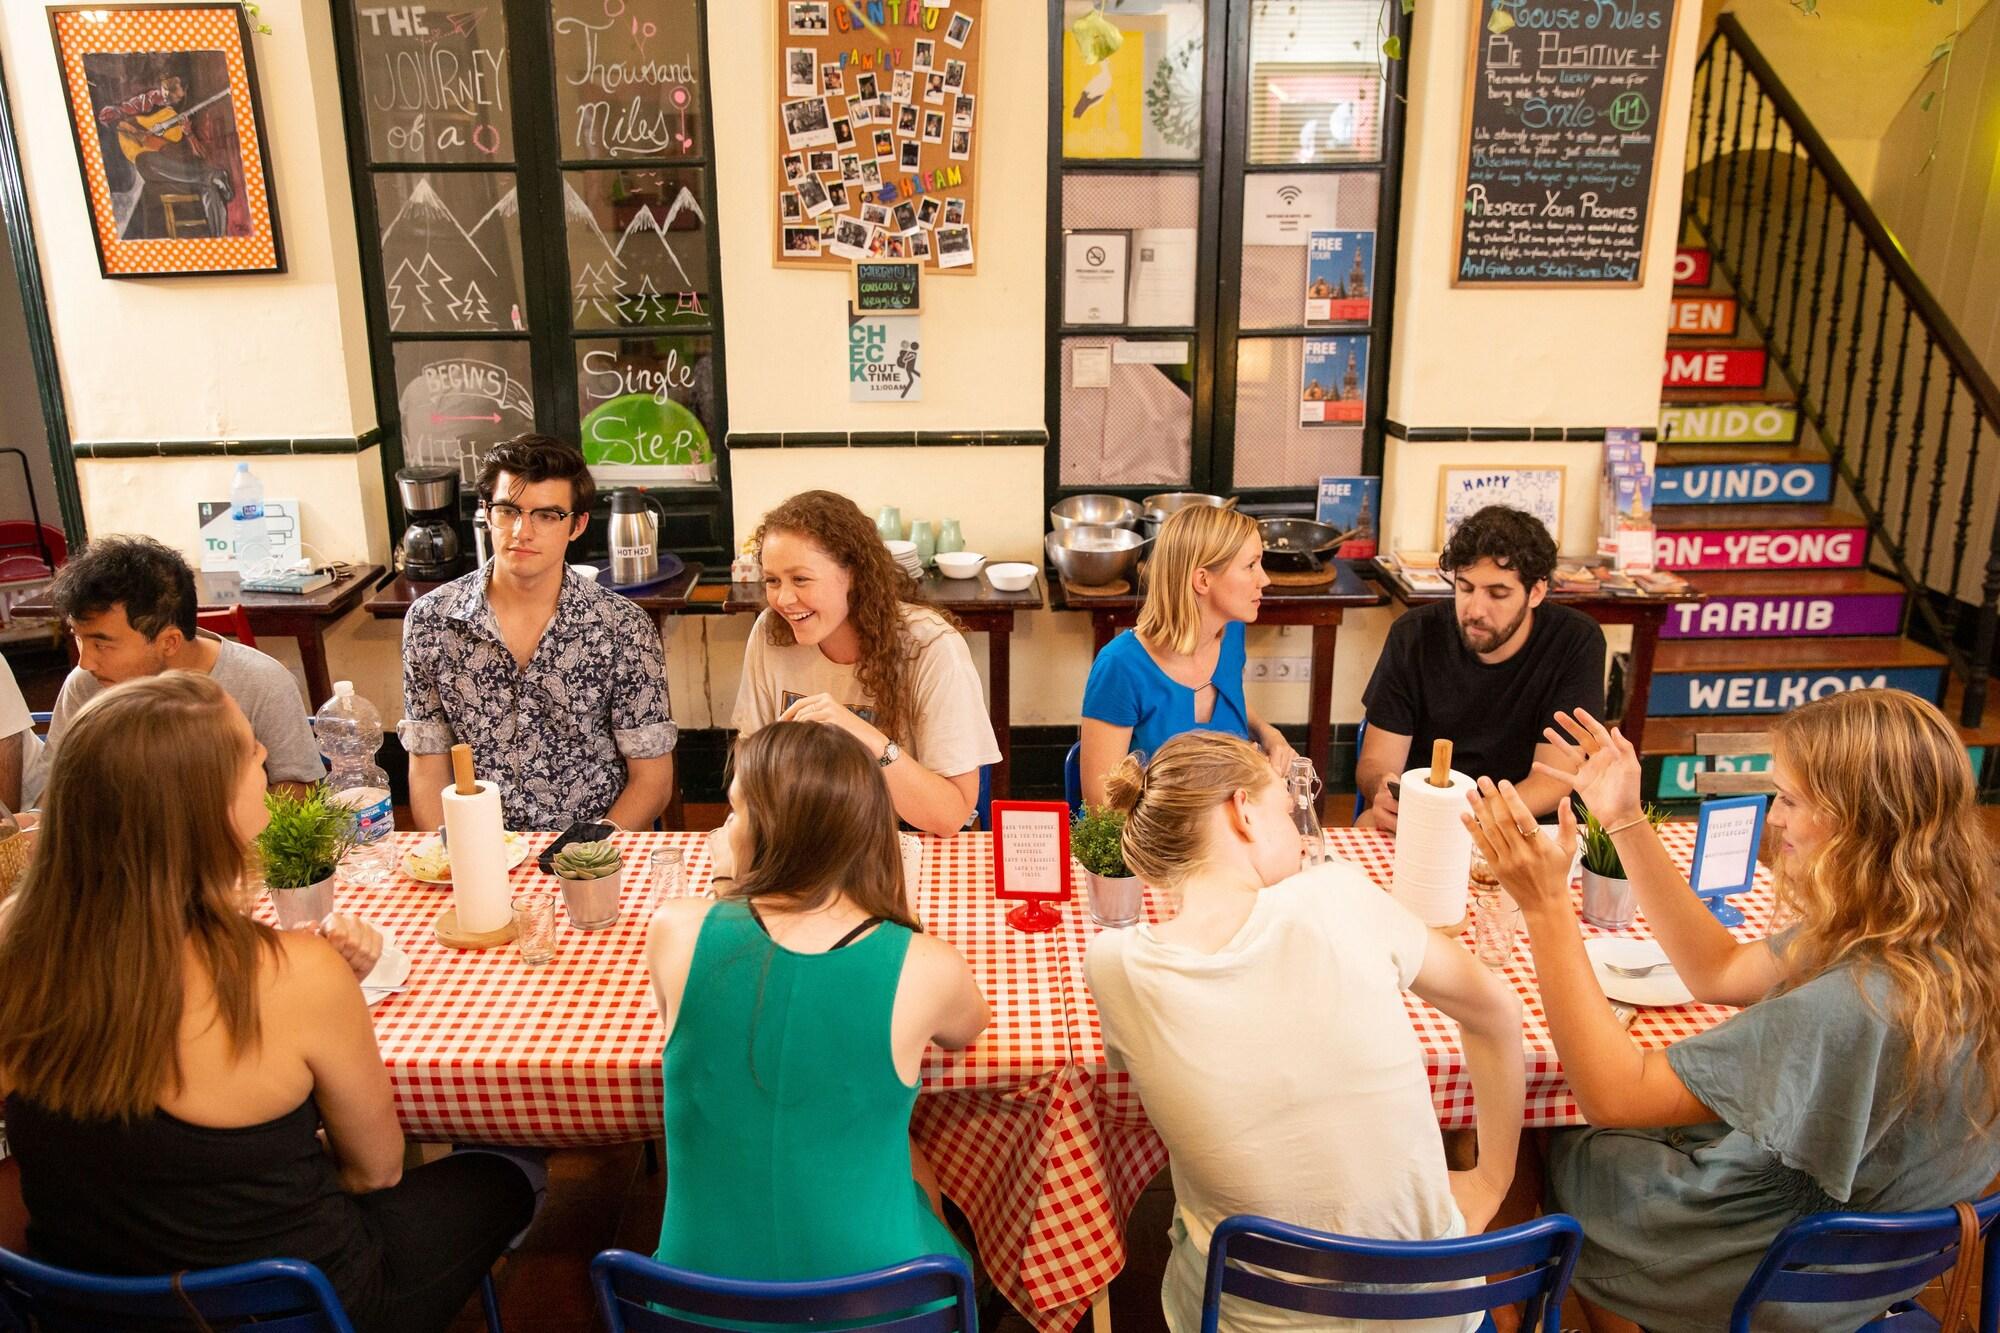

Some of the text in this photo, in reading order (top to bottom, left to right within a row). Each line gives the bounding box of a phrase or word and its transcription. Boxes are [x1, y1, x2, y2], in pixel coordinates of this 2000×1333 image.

[362, 6, 431, 37] THE
[556, 17, 697, 94] Thousand
[839, 48, 902, 71] FAMILY
[374, 43, 504, 115] JOURNEY
[1521, 98, 1596, 128] Smile
[387, 114, 465, 152] of a
[576, 96, 670, 156] Miles
[1311, 236, 1343, 251] FREE
[848, 325, 886, 343] CH
[848, 344, 884, 363] EC
[1306, 342, 1337, 355] FREE
[1306, 355, 1326, 363] TOUR
[582, 349, 696, 405] Single
[868, 364, 895, 373] OUT
[868, 373, 901, 382] TIME
[1663, 355, 1728, 382] ME
[424, 363, 501, 396] BEGINS
[1321, 483, 1352, 496] FREE
[1463, 475, 1510, 491] HAPPY
[1321, 496, 1340, 504] TOUR
[205, 538, 228, 551] To
[1675, 600, 1834, 633] TARHIB
